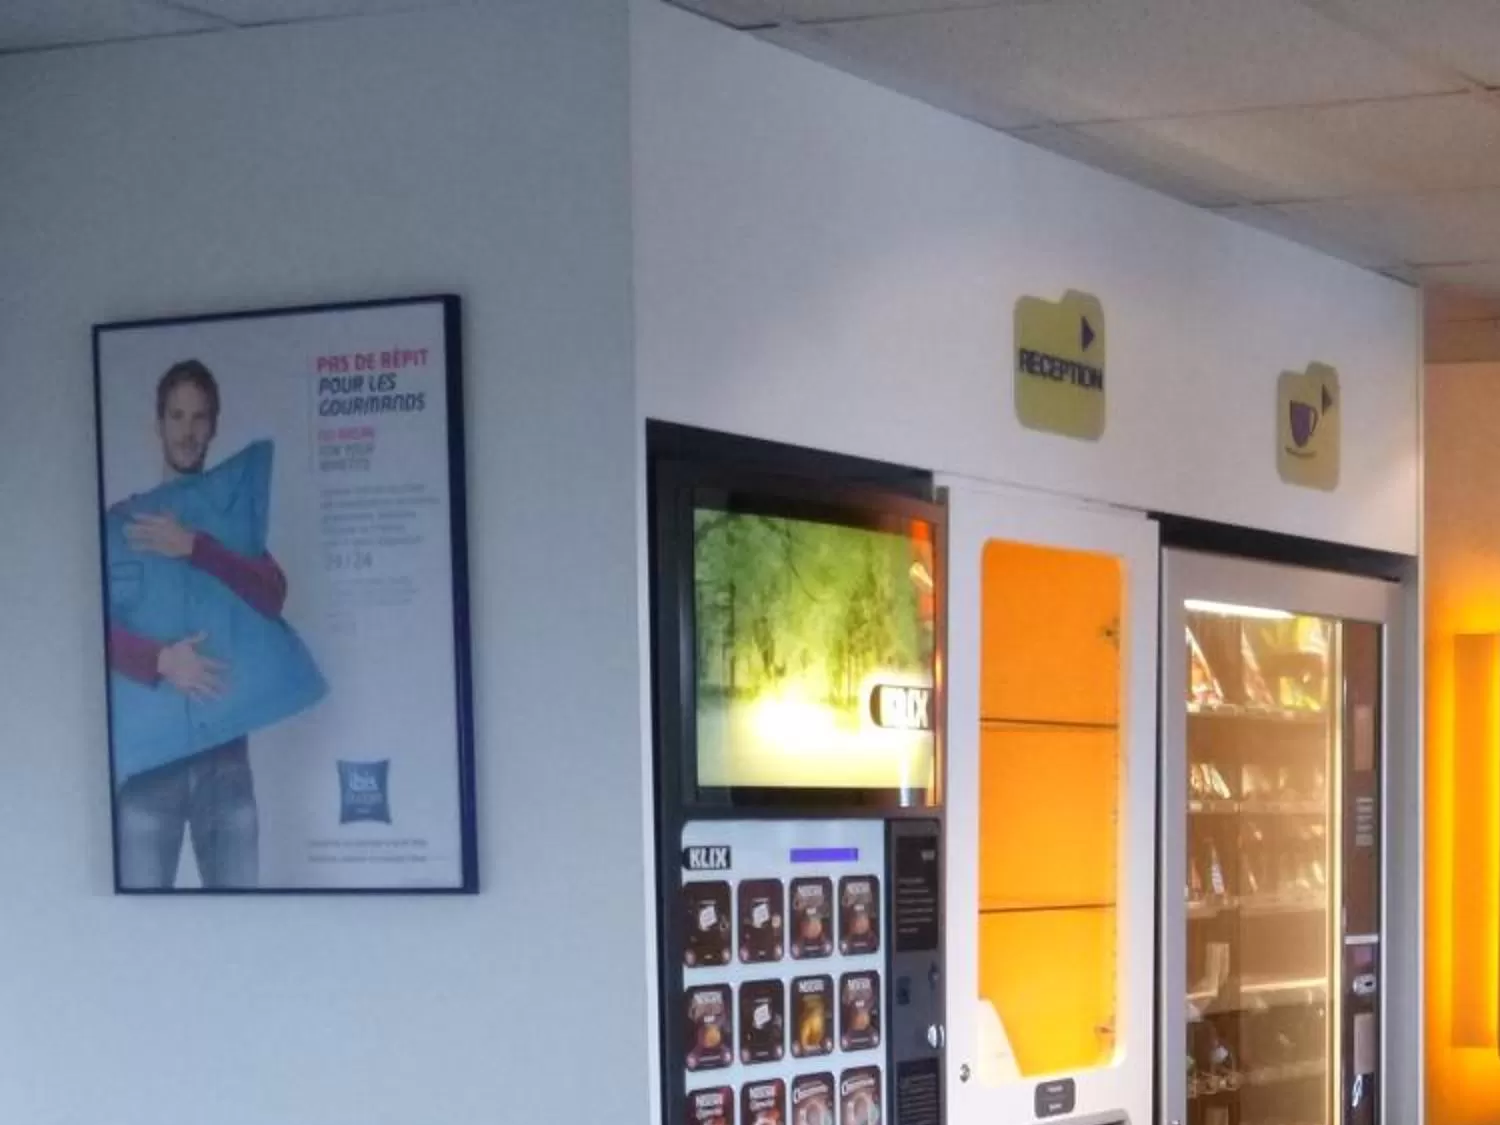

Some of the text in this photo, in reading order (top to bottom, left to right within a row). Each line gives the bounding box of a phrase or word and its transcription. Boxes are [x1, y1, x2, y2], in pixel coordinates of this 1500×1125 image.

[317, 355, 349, 373] PAS
[355, 352, 375, 371] DE
[1019, 347, 1103, 391] RECEPTION
[319, 371, 397, 396] POUR LES
[319, 391, 426, 417] GOURMANDS
[688, 847, 728, 869] KLIX
